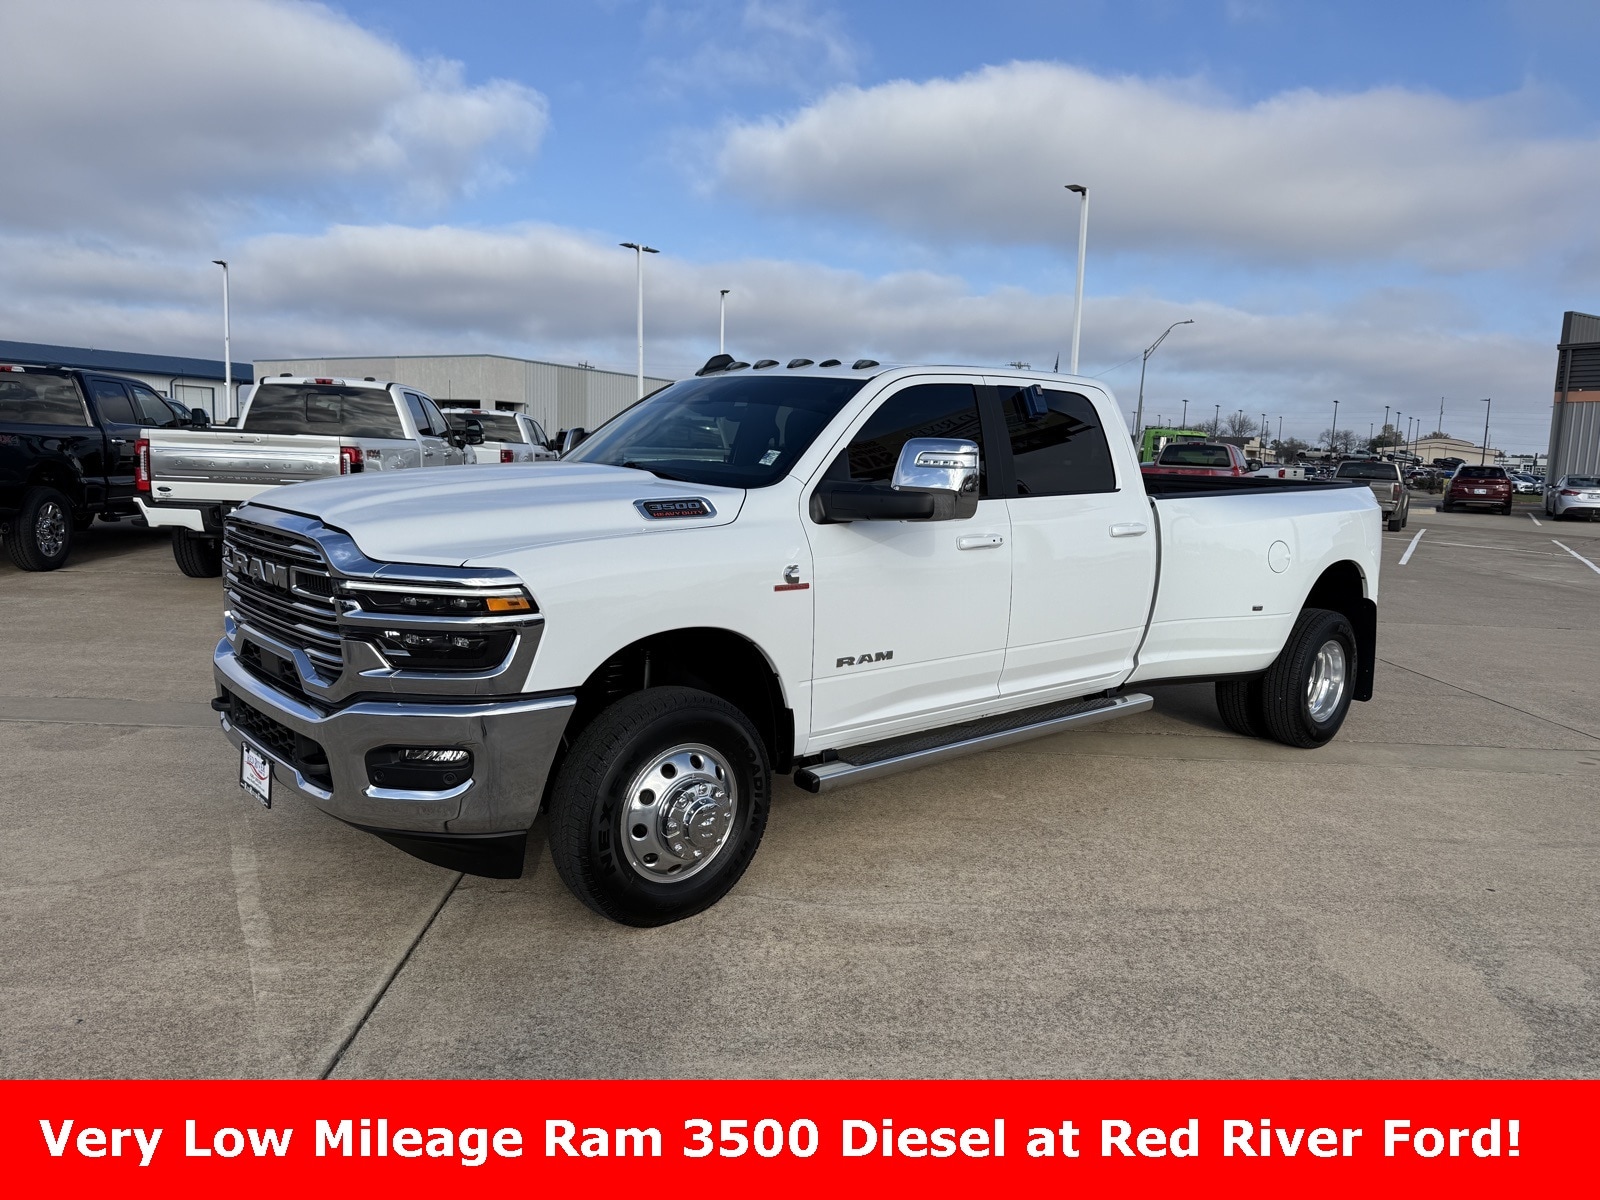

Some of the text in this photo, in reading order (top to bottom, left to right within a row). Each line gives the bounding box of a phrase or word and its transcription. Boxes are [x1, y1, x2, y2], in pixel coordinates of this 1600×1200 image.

[174, 459, 314, 471] PLATINUM
[648, 502, 700, 511] 3500
[233, 546, 289, 589] RAM
[836, 650, 893, 668] RAM
